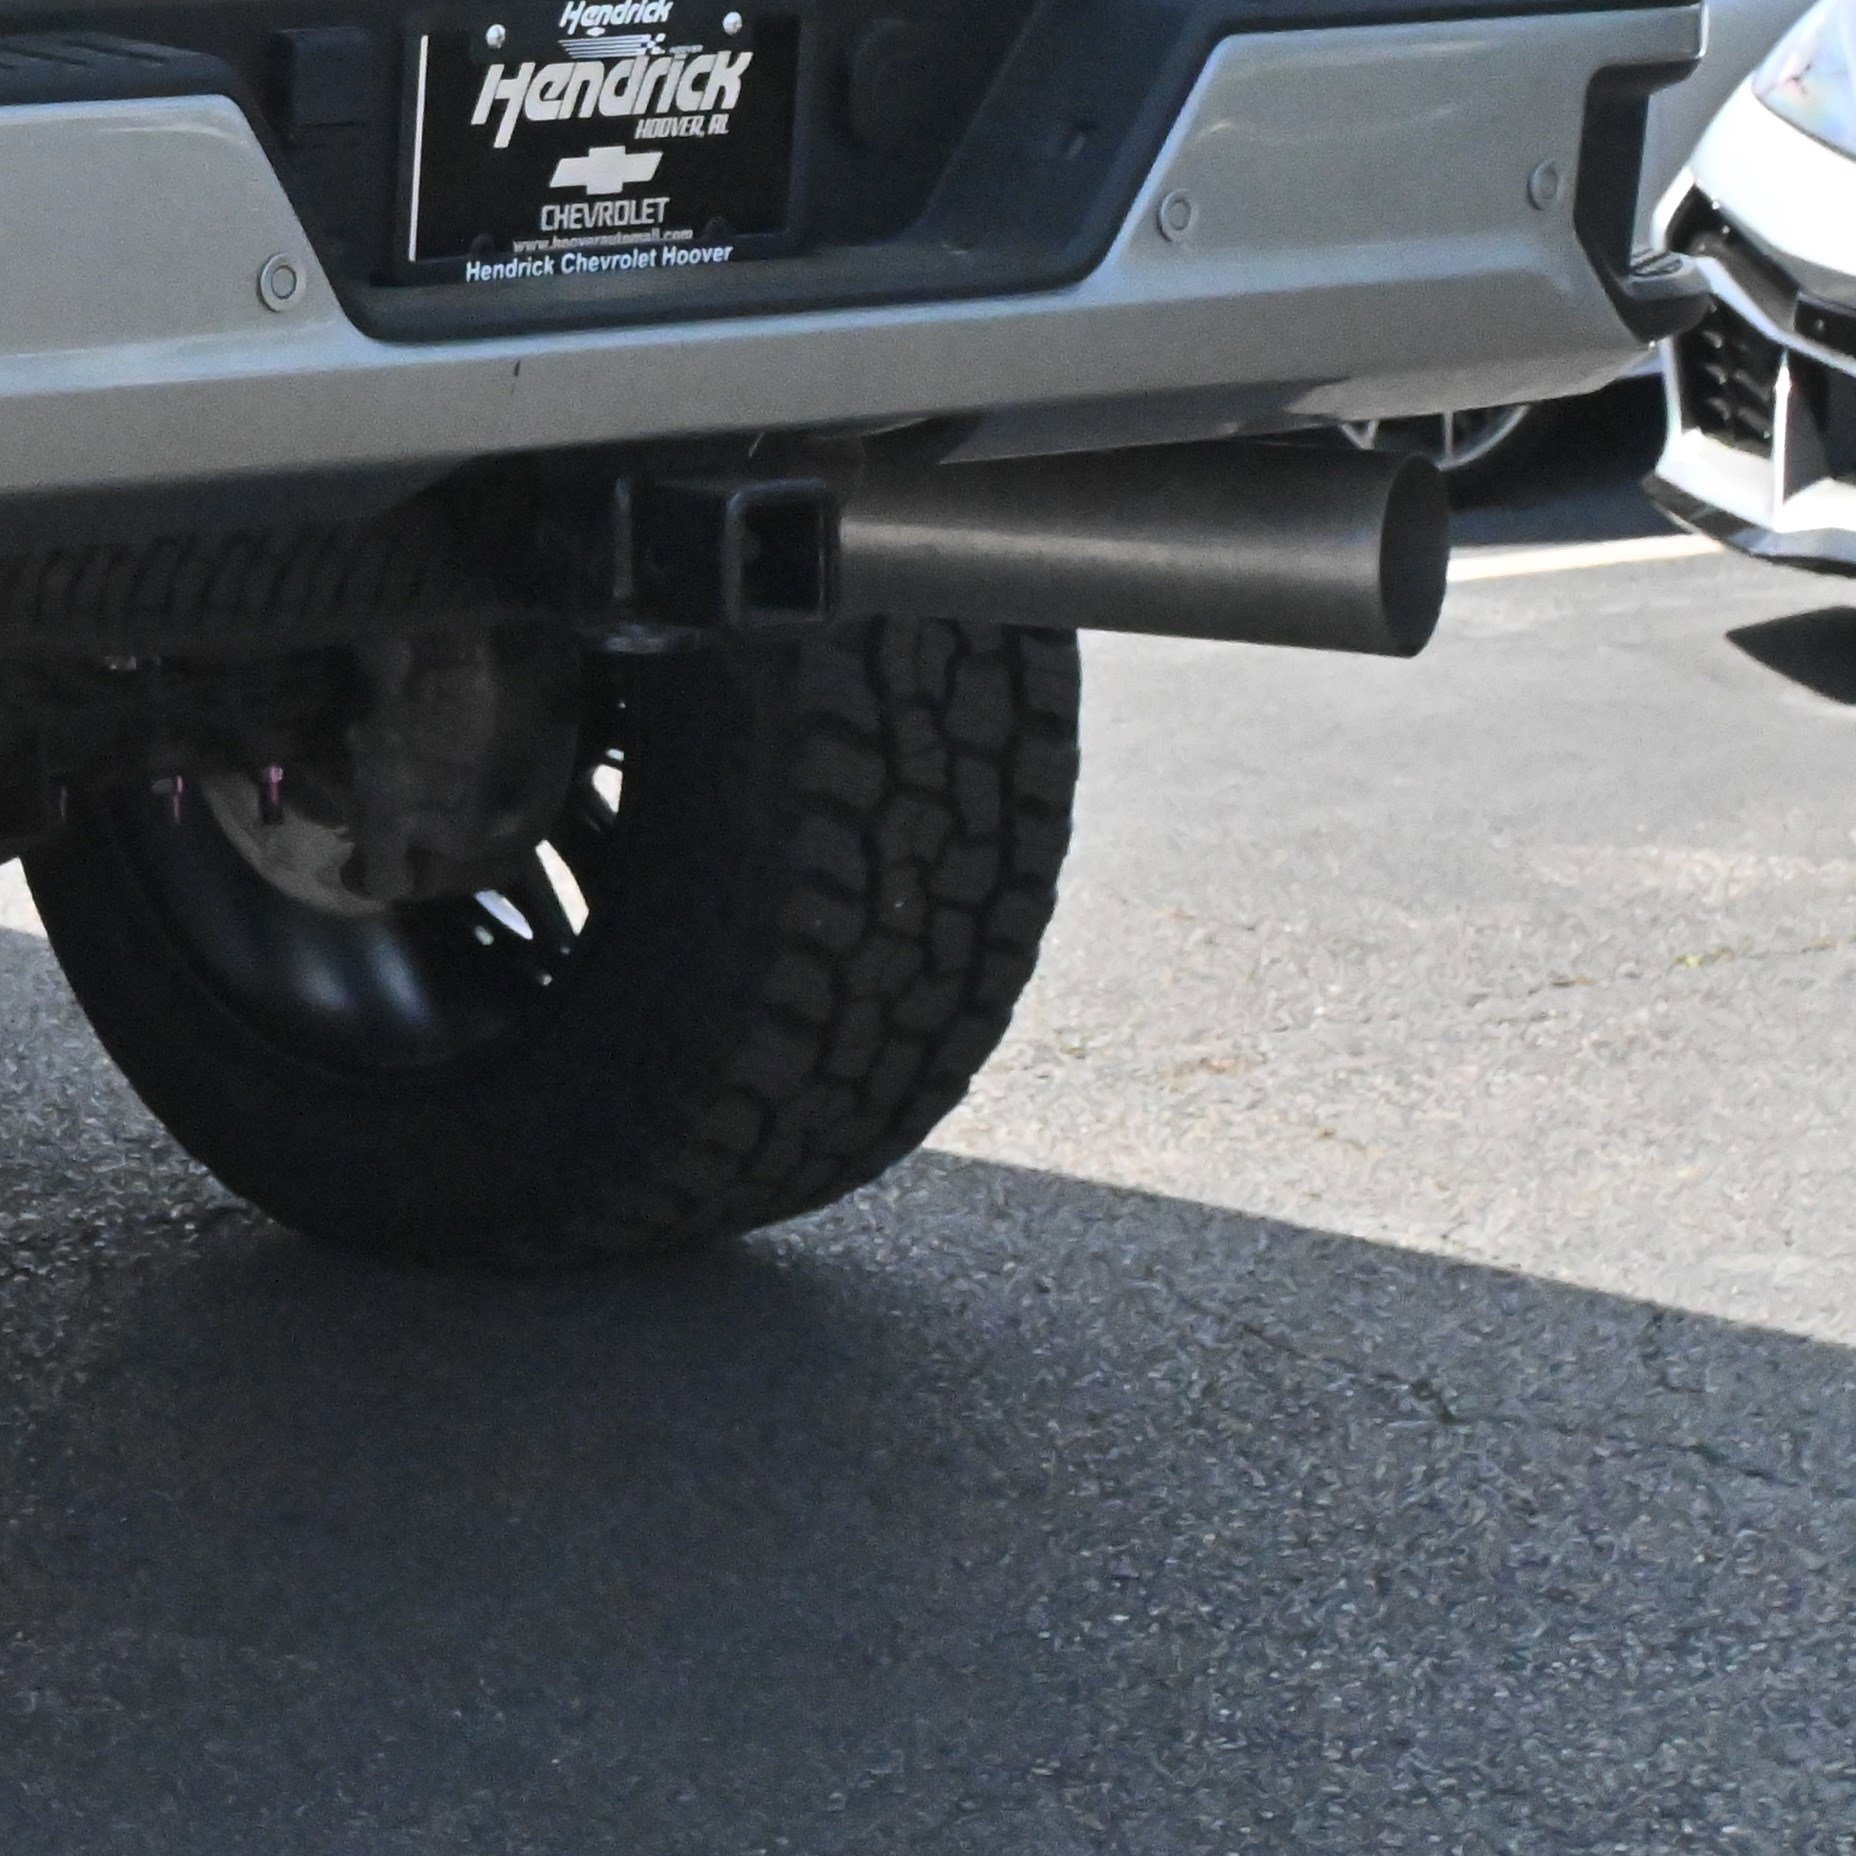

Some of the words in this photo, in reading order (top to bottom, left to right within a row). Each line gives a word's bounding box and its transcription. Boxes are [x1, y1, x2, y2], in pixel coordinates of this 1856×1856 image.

[471, 51, 753, 148] Hendrick
[634, 116, 705, 140] HOOVER,
[707, 114, 729, 135] AL
[540, 196, 670, 232] CHEVROLET
[466, 256, 555, 283] Hendrick
[561, 248, 657, 275] Chevrolet
[661, 245, 733, 267] Hoover
